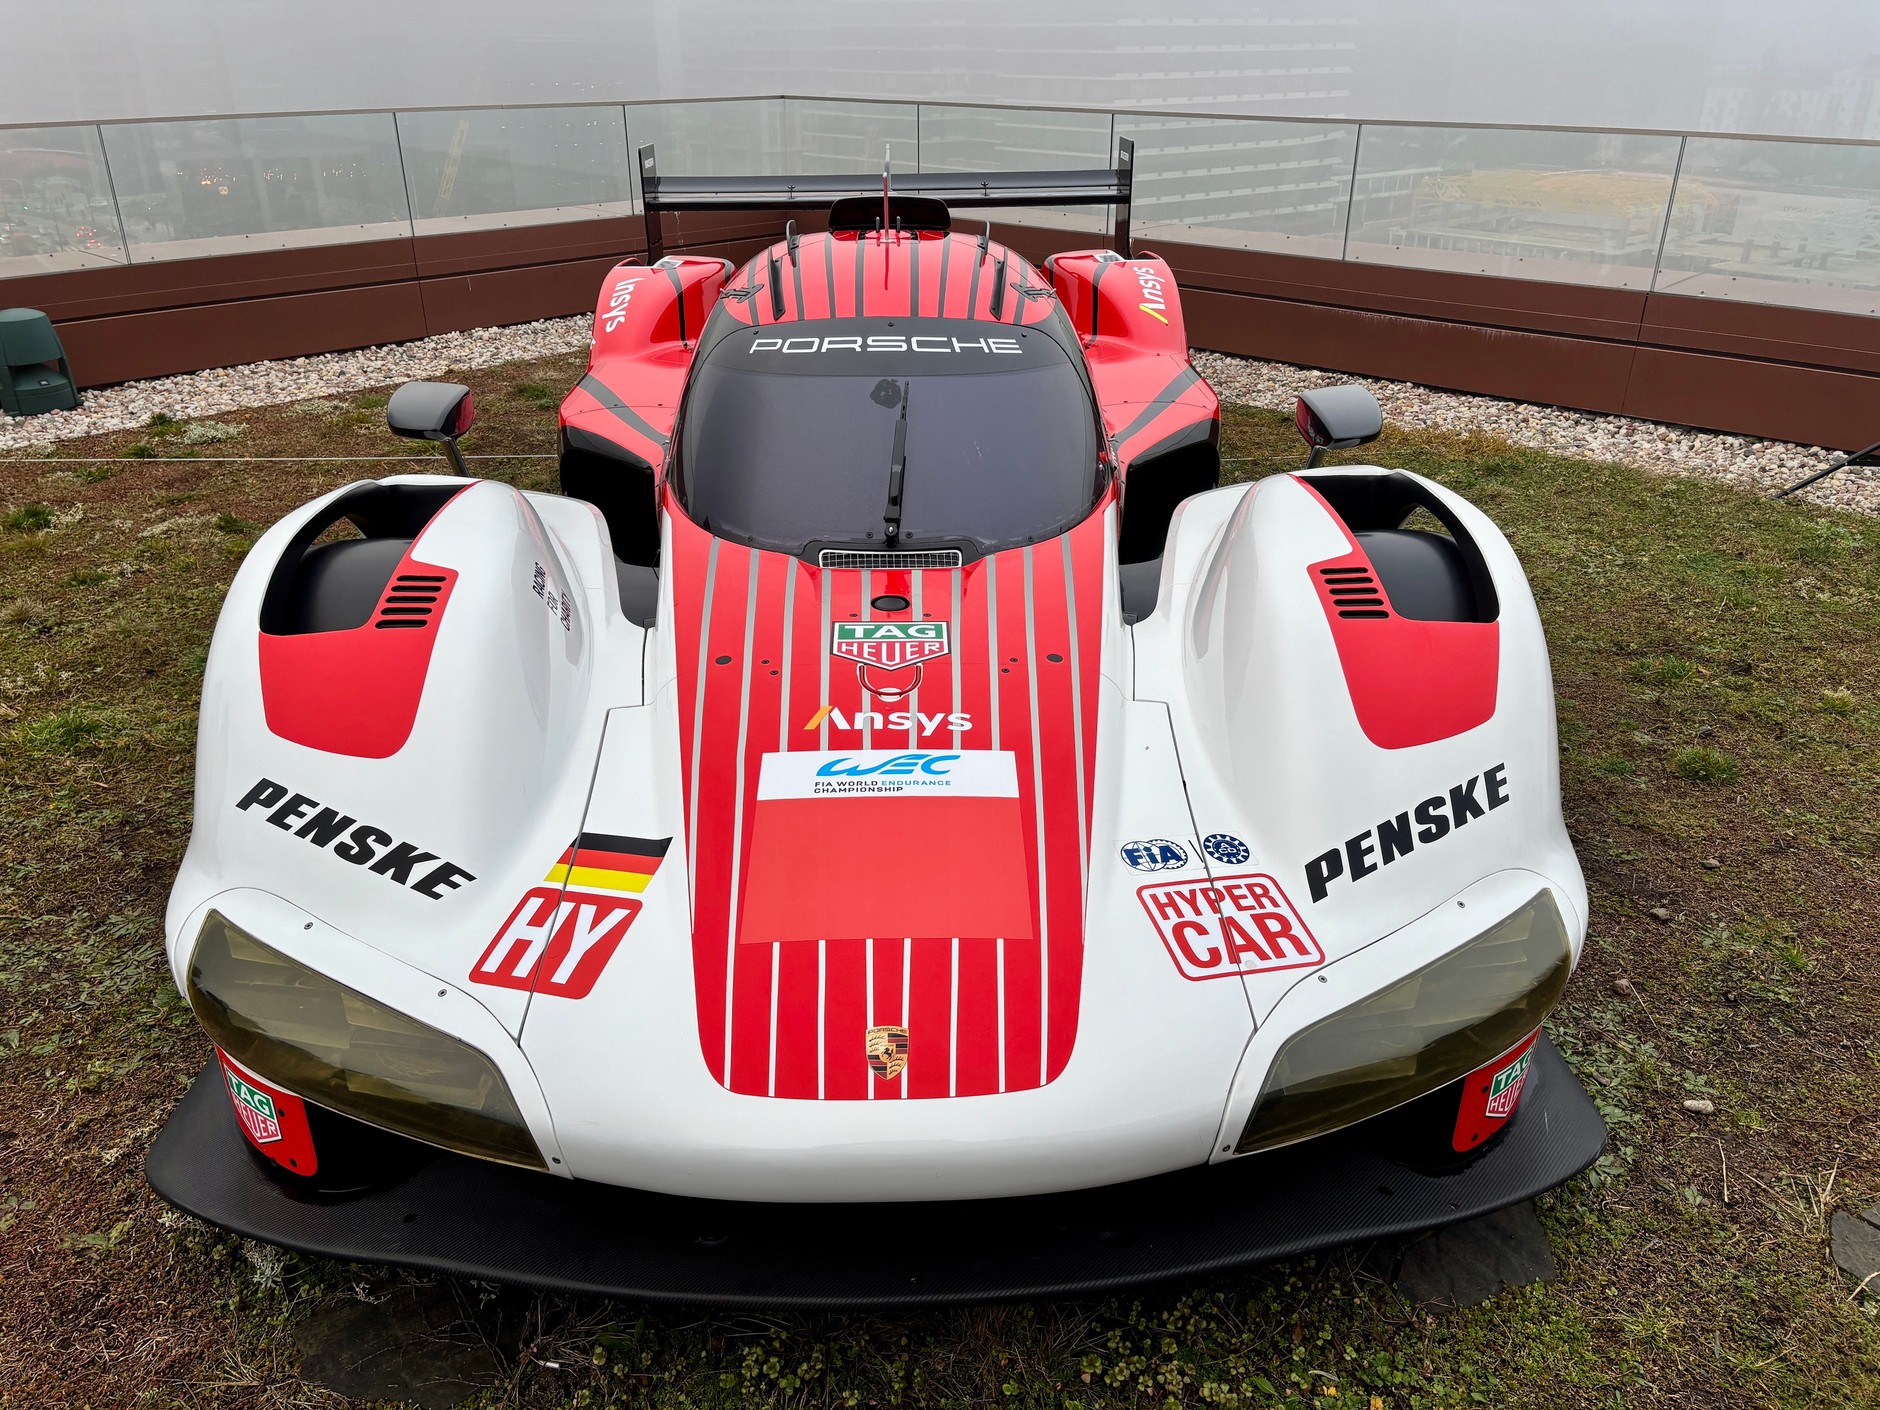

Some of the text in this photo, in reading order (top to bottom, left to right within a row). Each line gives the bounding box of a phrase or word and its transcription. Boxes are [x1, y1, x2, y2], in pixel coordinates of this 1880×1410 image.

[1132, 266, 1169, 325] Ansys
[749, 336, 1023, 354] PORSCHE
[532, 561, 546, 600] RACING
[546, 591, 559, 616] FOR
[560, 589, 571, 632] CHARITY
[844, 625, 937, 639] TAG
[841, 641, 941, 665] HEUER
[803, 705, 973, 737] Ansys
[815, 753, 962, 776] WEC
[813, 786, 904, 794] CHAMPIONSHIP
[235, 777, 477, 900] PENSKE
[1303, 762, 1510, 904] PENSKE
[1149, 882, 1281, 920] HYPER
[480, 896, 632, 984] HY
[1171, 912, 1312, 969] CAR
[867, 1027, 908, 1035] PORSCHE
[227, 1071, 271, 1116] TAG
[1489, 1069, 1528, 1112] HEUE
[231, 1091, 277, 1138] HEUER
